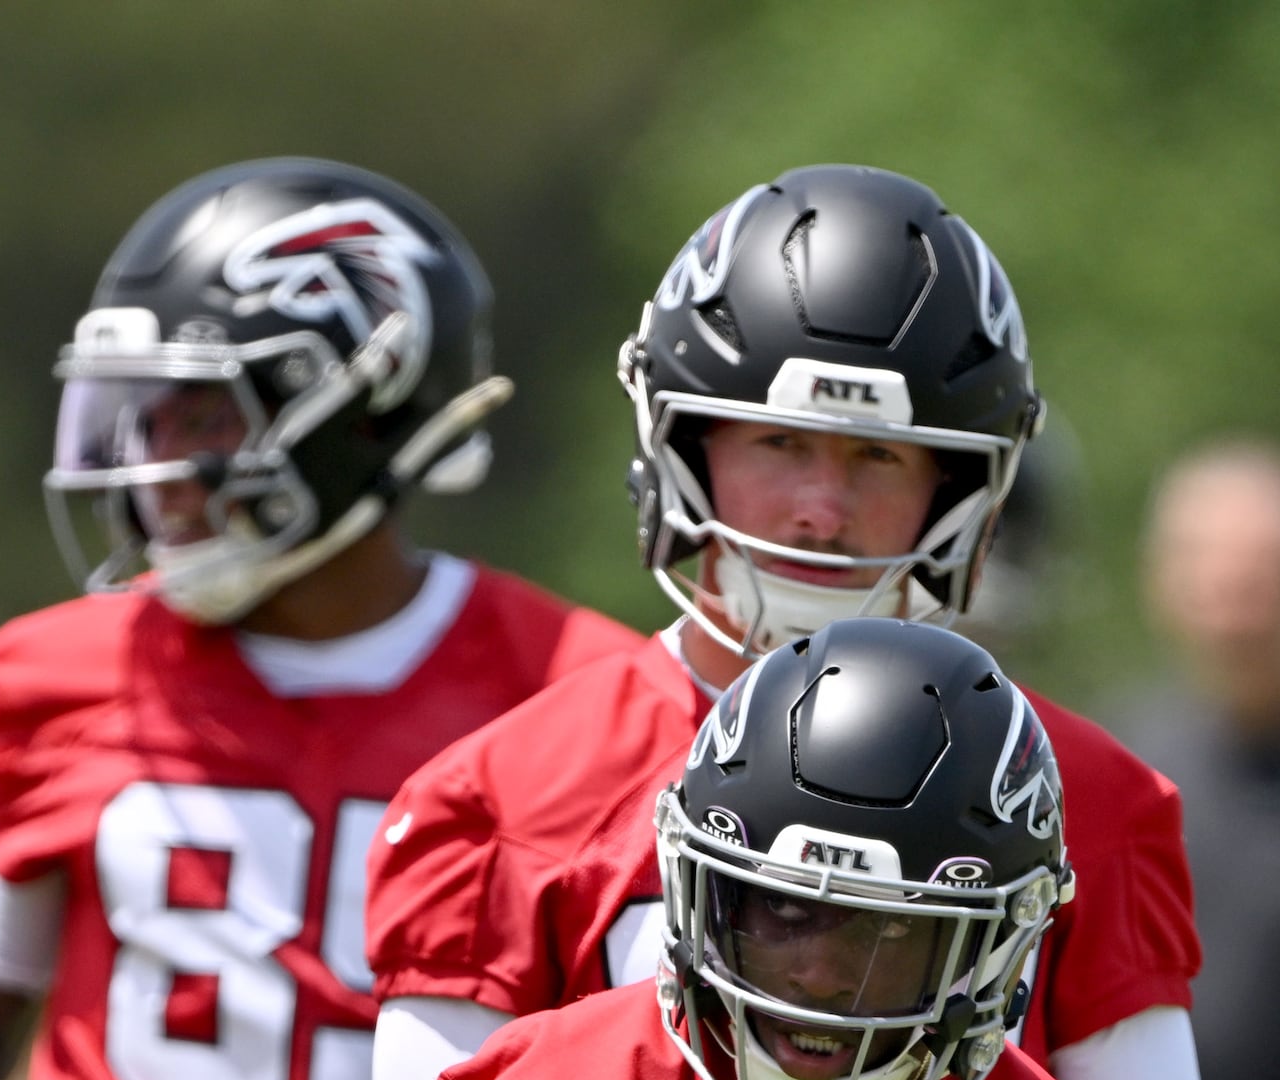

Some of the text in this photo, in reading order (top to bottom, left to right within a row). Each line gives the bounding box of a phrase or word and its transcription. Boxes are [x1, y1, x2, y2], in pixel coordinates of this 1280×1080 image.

[811, 374, 880, 404] ATL
[702, 821, 742, 848] OAKLEY
[800, 838, 872, 871] ATL
